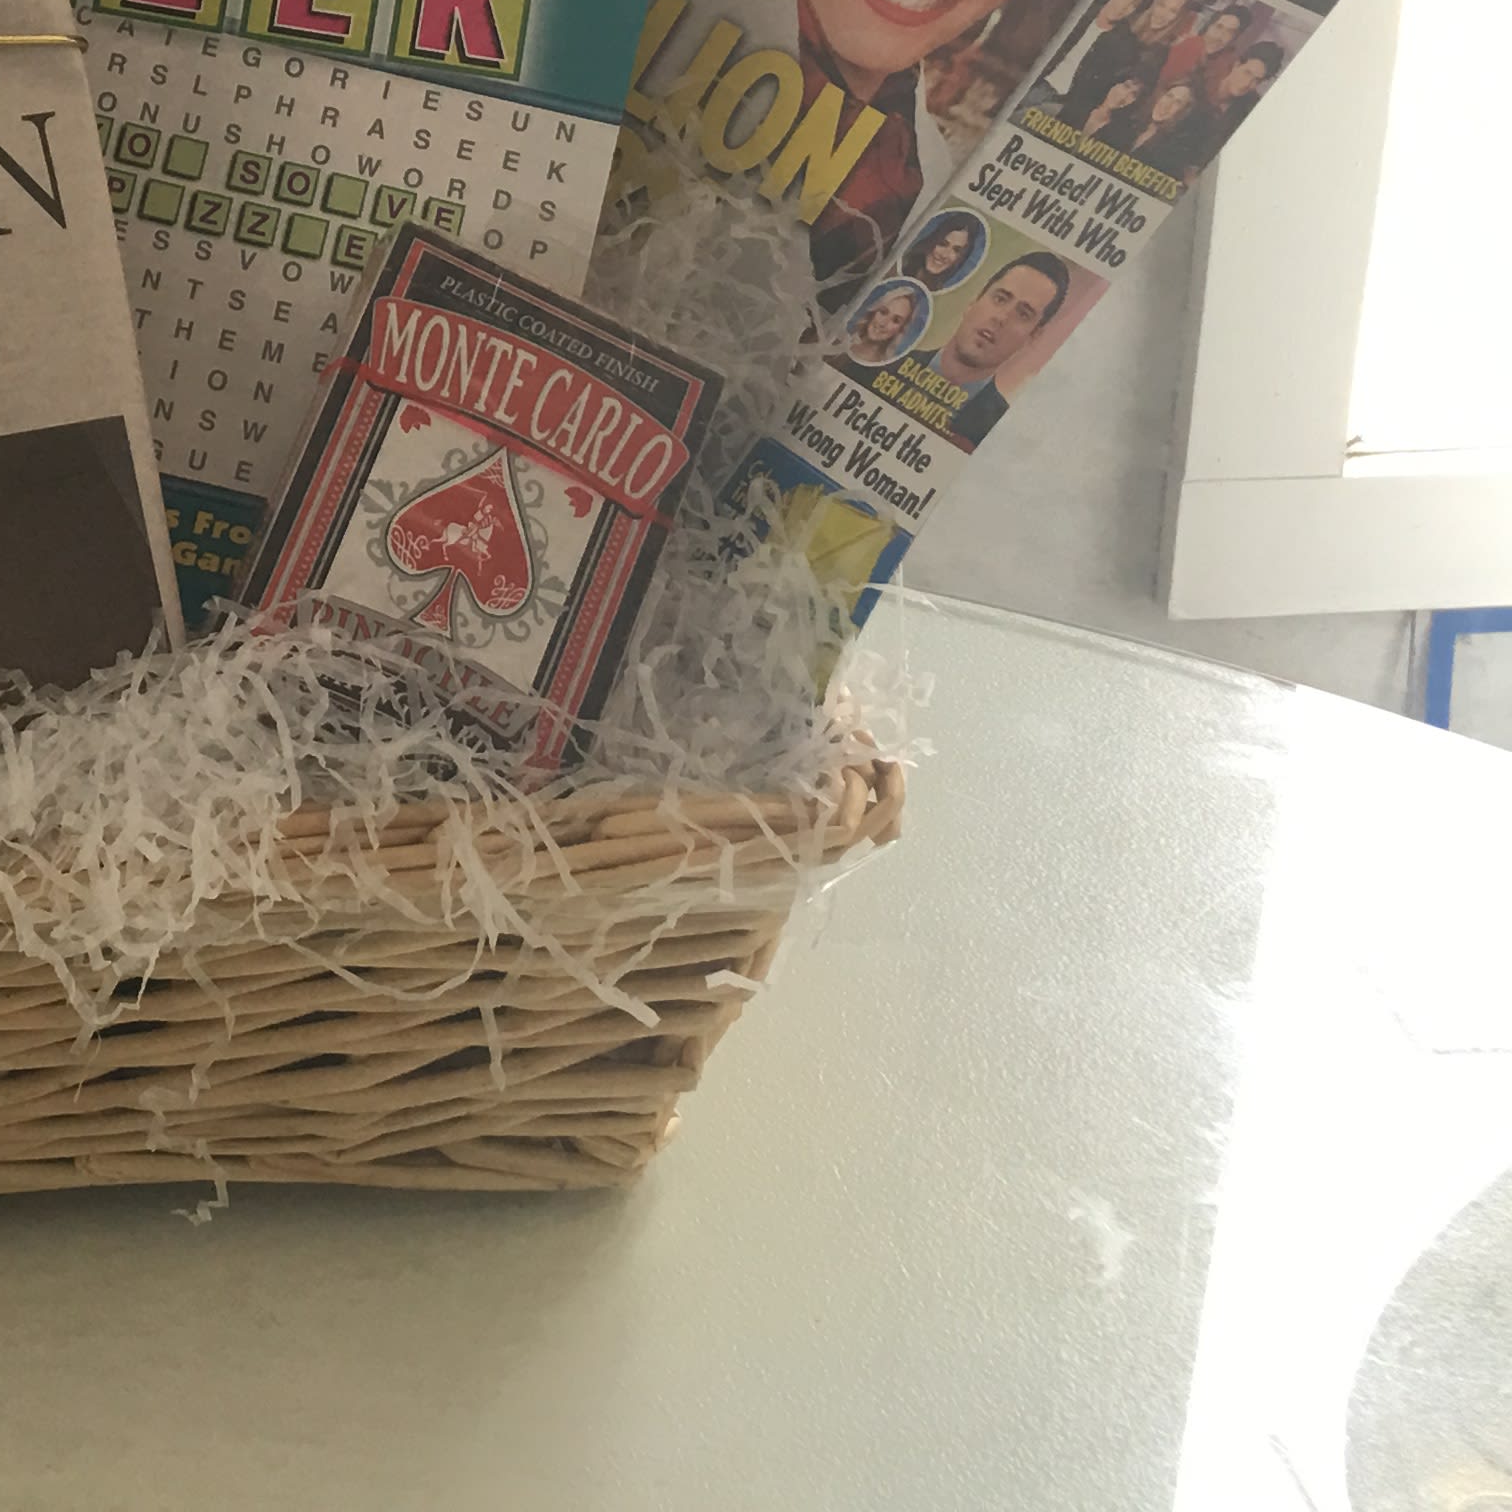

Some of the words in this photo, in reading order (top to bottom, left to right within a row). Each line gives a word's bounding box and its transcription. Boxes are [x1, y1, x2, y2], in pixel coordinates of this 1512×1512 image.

[1020, 109, 1080, 148] FRIENDS
[1077, 134, 1117, 168] WITH
[1113, 153, 1180, 200] BENEFITS
[968, 162, 1027, 212] Slept
[1021, 188, 1079, 241] With
[1073, 217, 1127, 268] Who
[1094, 182, 1147, 234] Who
[440, 275, 518, 325] PLASTIC
[517, 304, 594, 361] COATED
[591, 340, 661, 393] FINISH
[377, 301, 536, 427] MONTE
[530, 368, 675, 501] CARLO
[871, 371, 903, 401] BEN
[897, 357, 969, 411] BACHELOR
[786, 399, 847, 469] Wrong
[843, 441, 937, 521] Woman!
[835, 388, 905, 453] Picked
[896, 423, 933, 475] the
